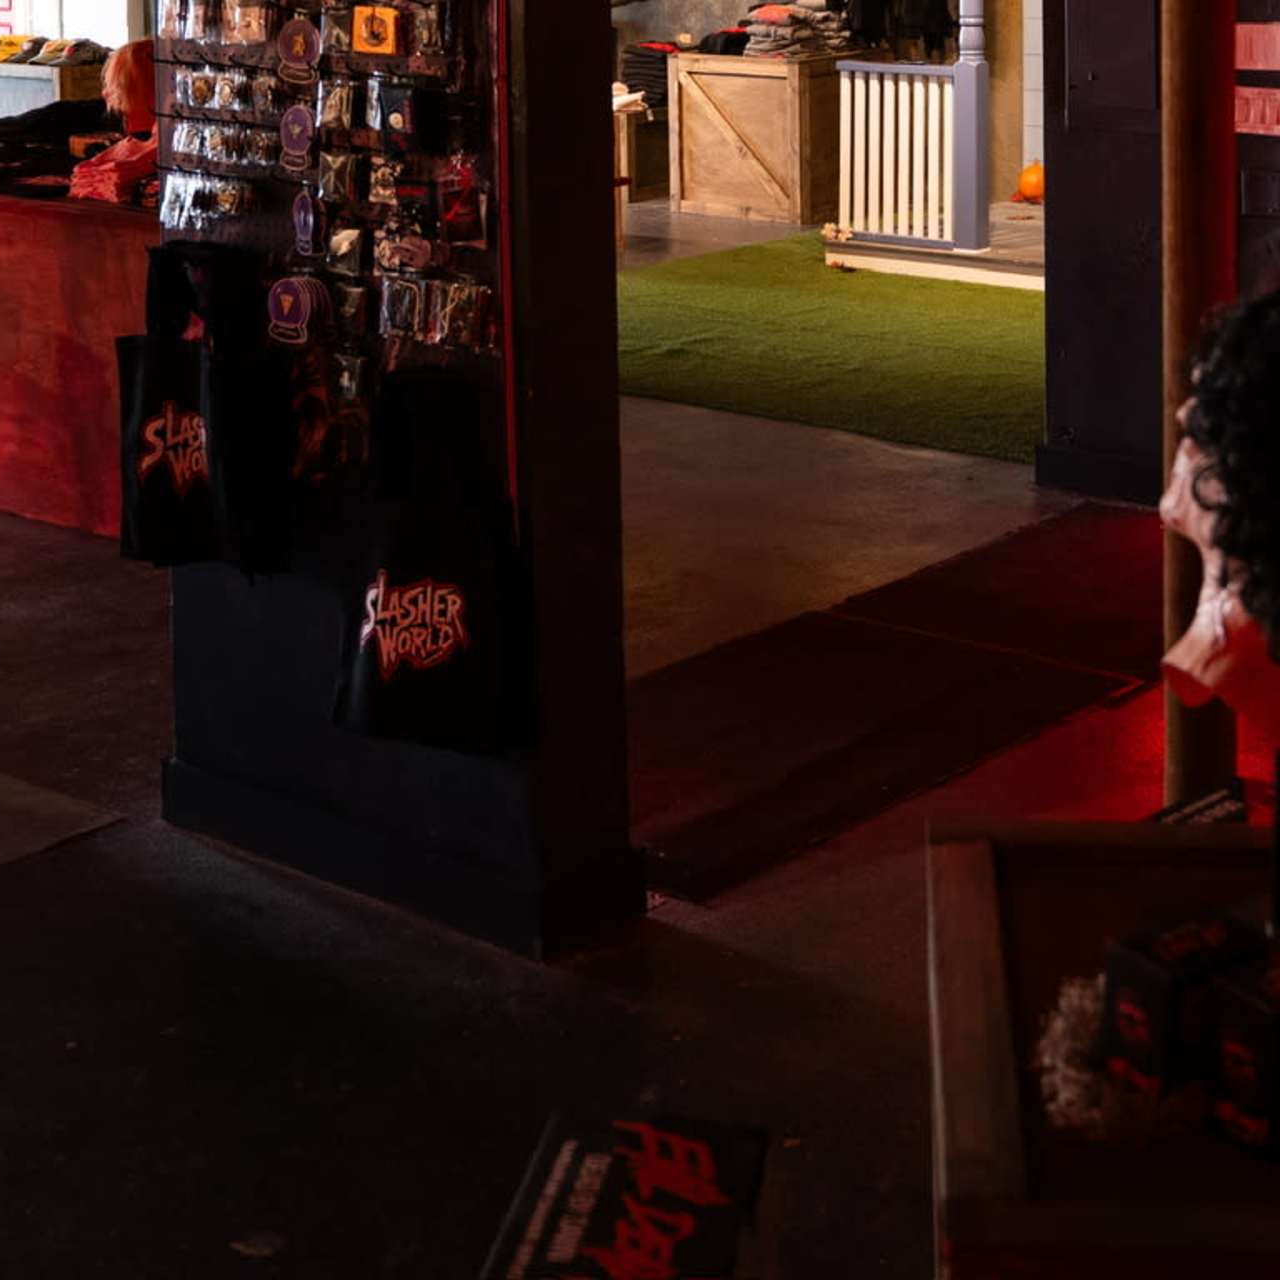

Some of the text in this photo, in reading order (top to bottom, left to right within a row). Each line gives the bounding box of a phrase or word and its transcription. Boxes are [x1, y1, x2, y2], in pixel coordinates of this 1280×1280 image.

[140, 400, 207, 472] SLAS
[360, 568, 466, 651] SLASHER
[375, 623, 456, 670] WORLD
